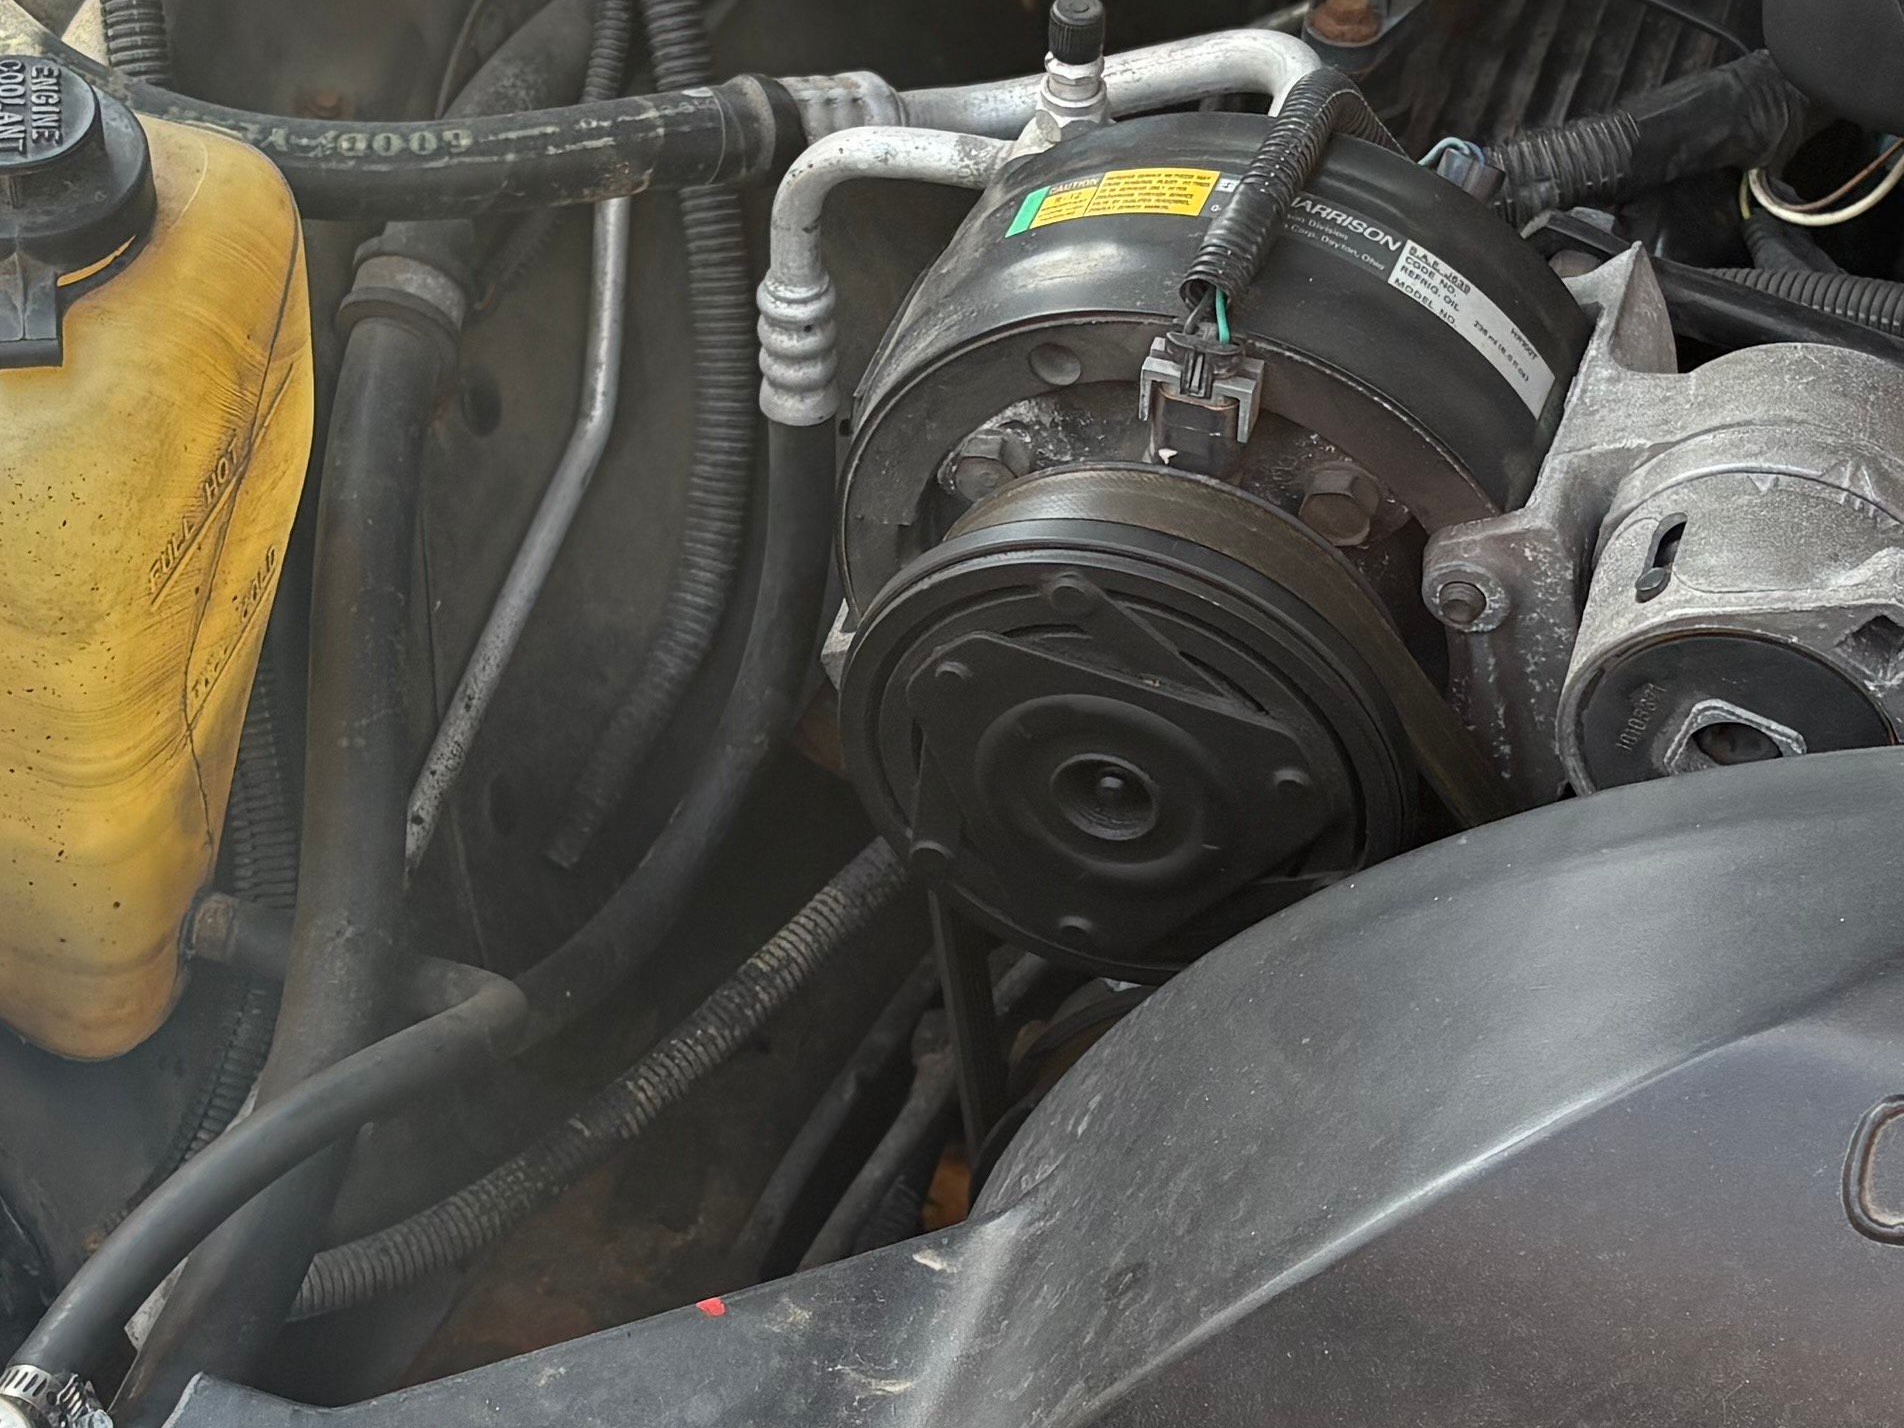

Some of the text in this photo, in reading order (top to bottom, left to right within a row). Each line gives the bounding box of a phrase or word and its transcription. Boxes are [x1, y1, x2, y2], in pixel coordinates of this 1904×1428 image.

[32, 65, 63, 147] ENGINE
[1404, 254, 1459, 297] CODE NO.
[1393, 276, 1459, 327] MODEL NO.
[1441, 294, 1462, 312] OIL
